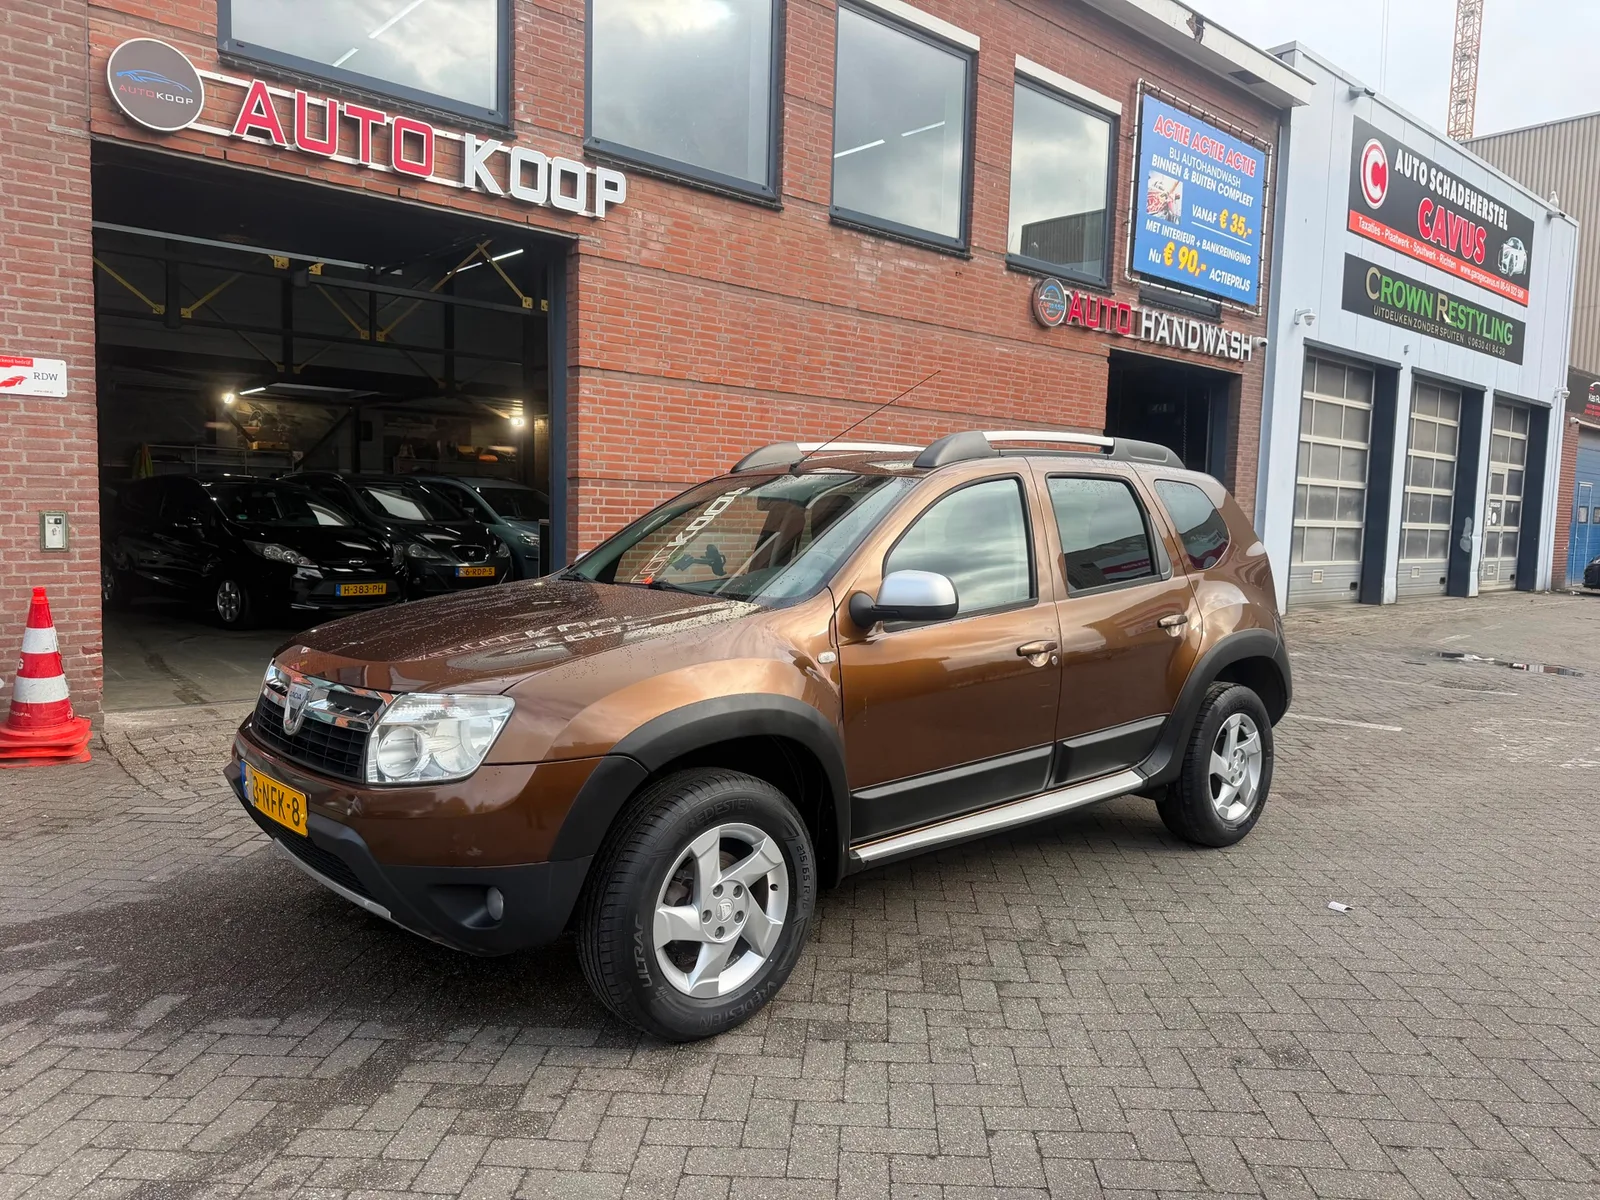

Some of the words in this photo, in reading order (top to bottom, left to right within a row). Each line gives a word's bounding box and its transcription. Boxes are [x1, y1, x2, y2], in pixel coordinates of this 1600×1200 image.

[118, 84, 194, 105] AUTOKOOP
[231, 78, 436, 180] AUTO
[463, 132, 627, 219] KOOP
[1153, 114, 1190, 145] ACTIE
[1191, 133, 1225, 163] ACTIE
[1225, 150, 1257, 178] ACTIE
[1169, 146, 1180, 162] BIJ
[1181, 150, 1241, 187] AUTOHANDWASH
[1152, 154, 1182, 176] BINNEN
[1182, 168, 1190, 180] &
[1190, 172, 1217, 194] BUITEN
[1217, 183, 1254, 208] COMPLEET
[1394, 148, 1428, 186] AUTO
[1429, 167, 1508, 231] SCHADEHERSTEL
[1191, 203, 1217, 224] VANAF
[1219, 208, 1229, 229] €
[1417, 197, 1487, 265] CAVUS
[1145, 220, 1161, 236] MET
[1161, 223, 1196, 246] INTERIEUR
[1196, 239, 1202, 248] +
[1201, 238, 1251, 266] BANKREINIGING
[1148, 248, 1161, 265] Nu
[1163, 241, 1175, 267] €
[1209, 267, 1251, 293] ACTIEPRIJS
[1066, 290, 1132, 335] AUTO
[1140, 307, 1253, 362] HANDWASH
[1365, 266, 1433, 320] CROWN
[1436, 292, 1514, 346] RESTYLING
[1373, 305, 1413, 326] UITDEUKEN
[1412, 318, 1439, 336] ZONDER
[1439, 327, 1465, 343] SPUITEN
[33, 371, 59, 382] RDW
[343, 584, 385, 595] H-383-PH
[463, 566, 494, 577] 6-RDP-5
[252, 775, 300, 827] 3-NFK-8
[633, 913, 653, 988] ULTRAC
